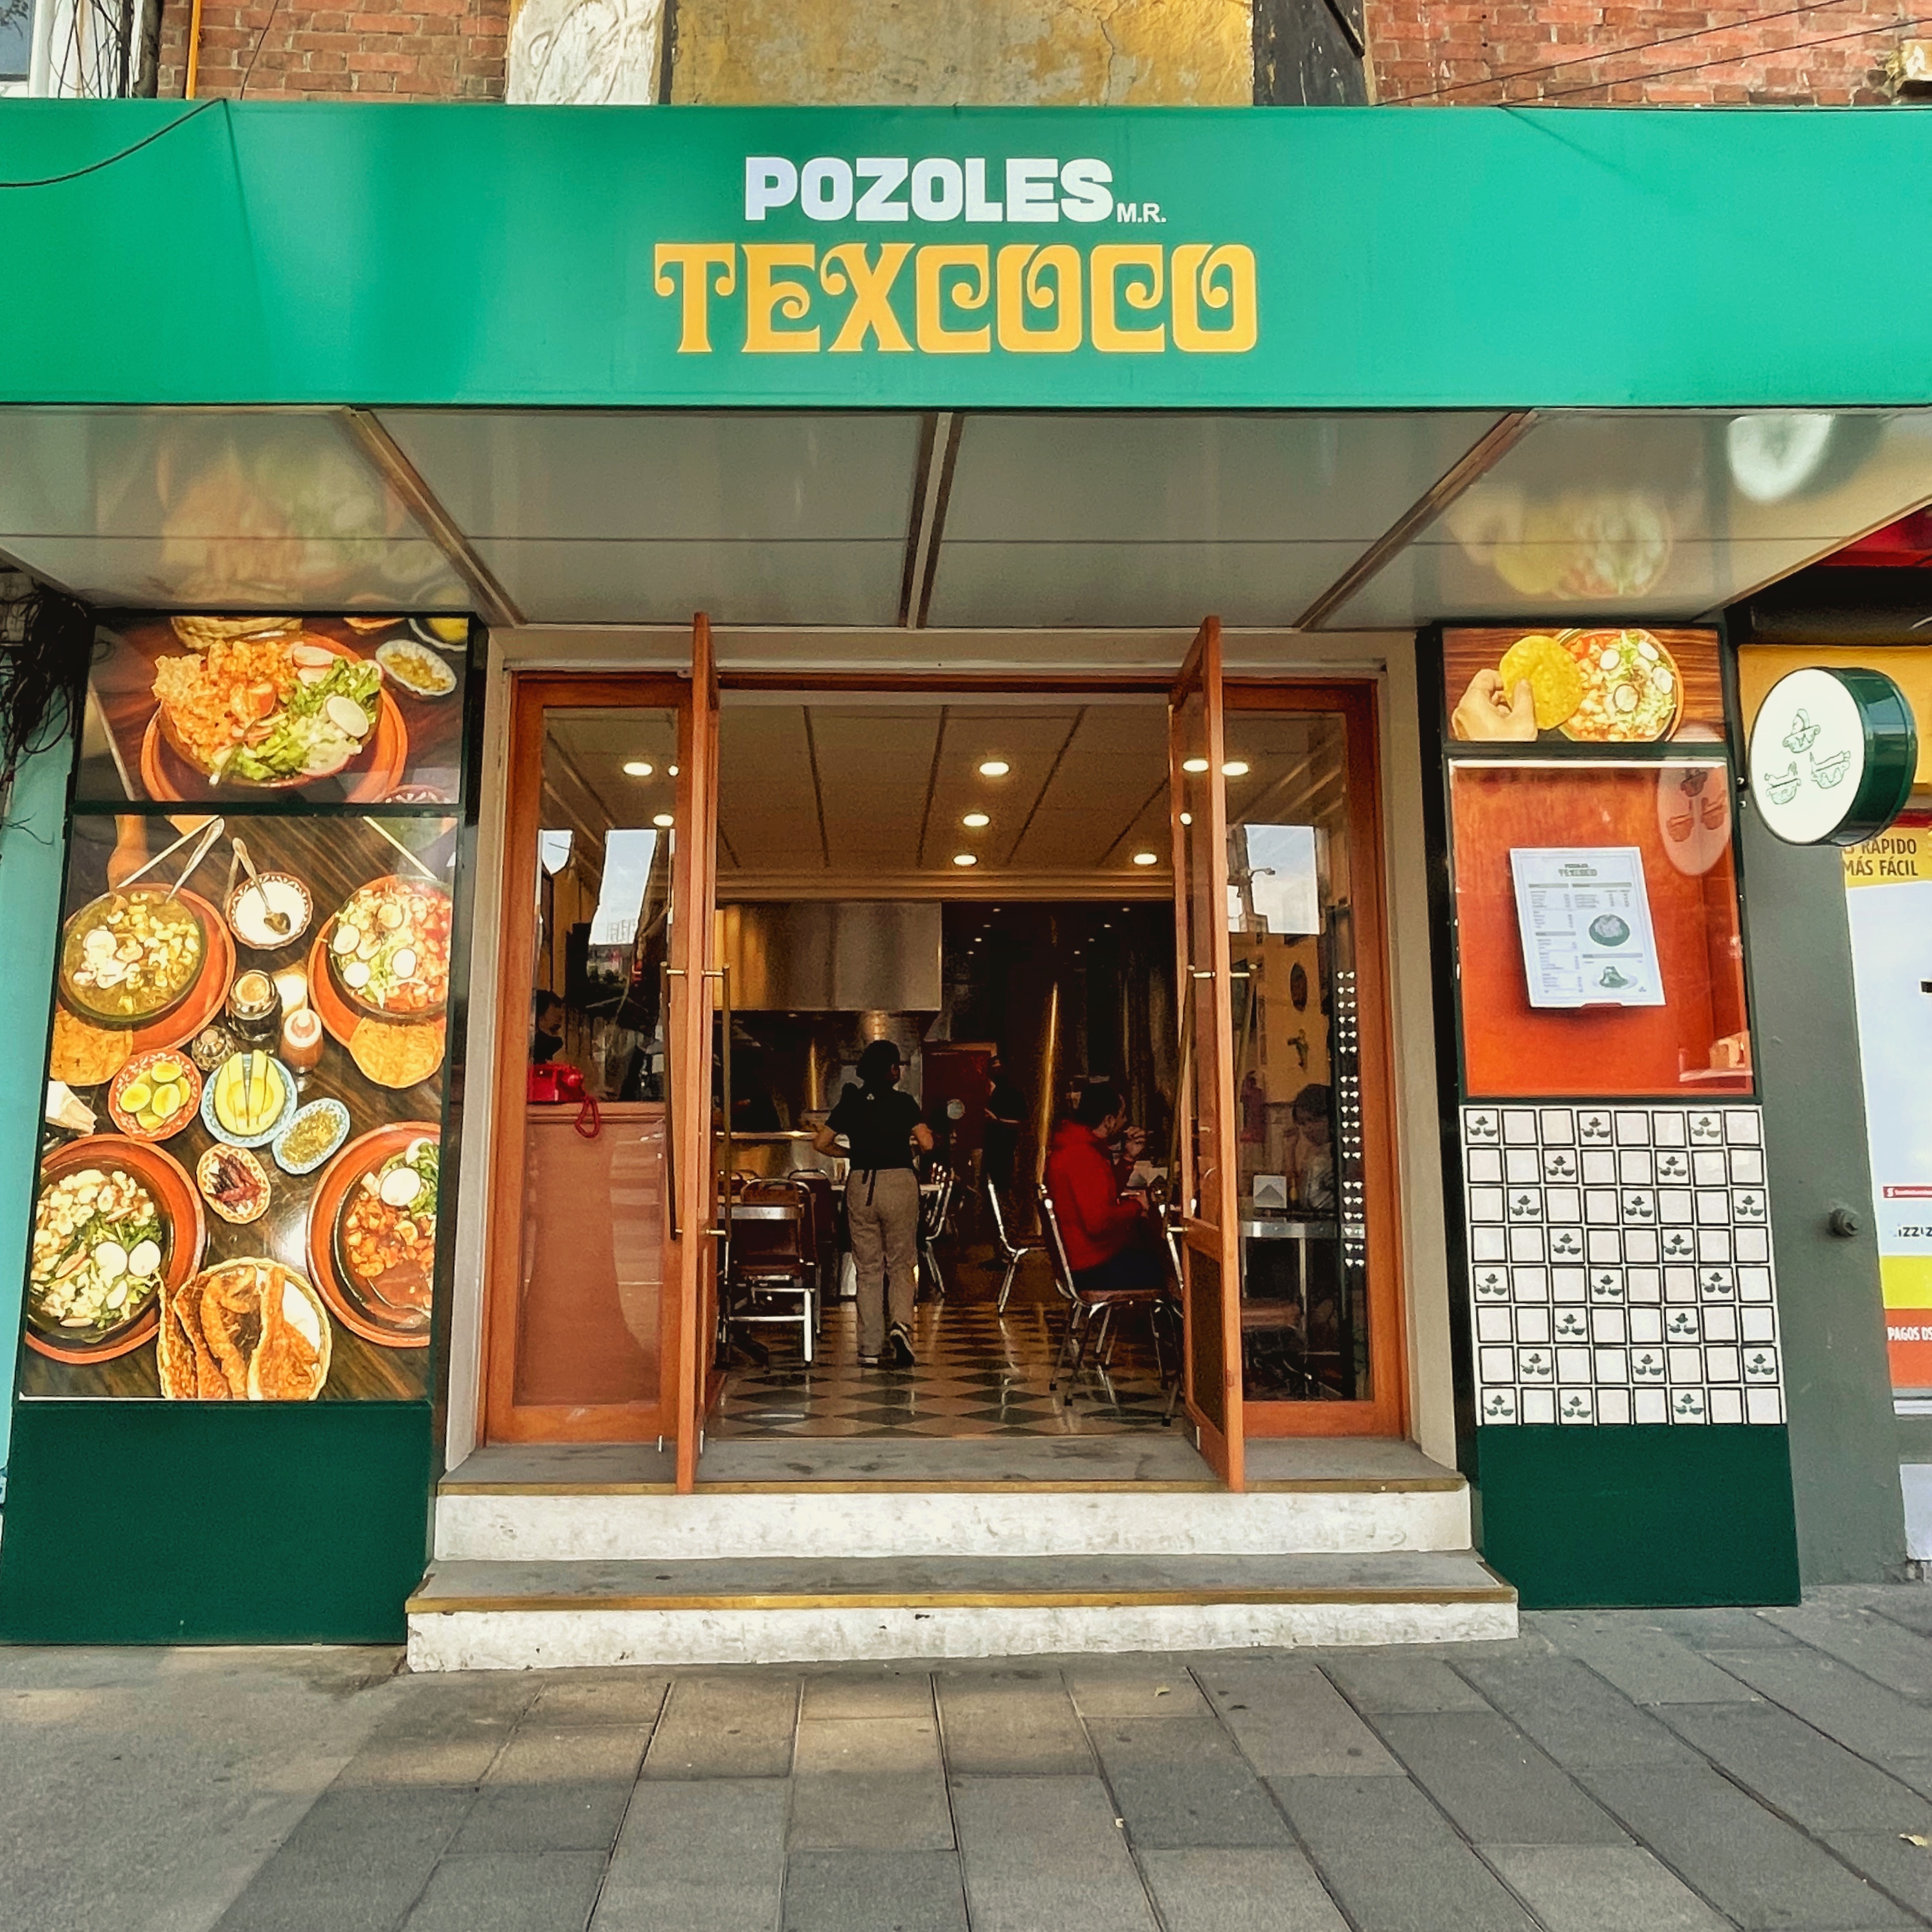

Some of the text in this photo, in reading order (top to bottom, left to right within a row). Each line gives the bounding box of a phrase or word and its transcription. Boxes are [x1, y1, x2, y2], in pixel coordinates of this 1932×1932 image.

[745, 156, 1167, 223] POZOLES M.R.
[653, 242, 1258, 354] TEXCOCO
[1842, 855, 1918, 876] MÁS FÁCIL
[1887, 1326, 1920, 1342] PAGOS
